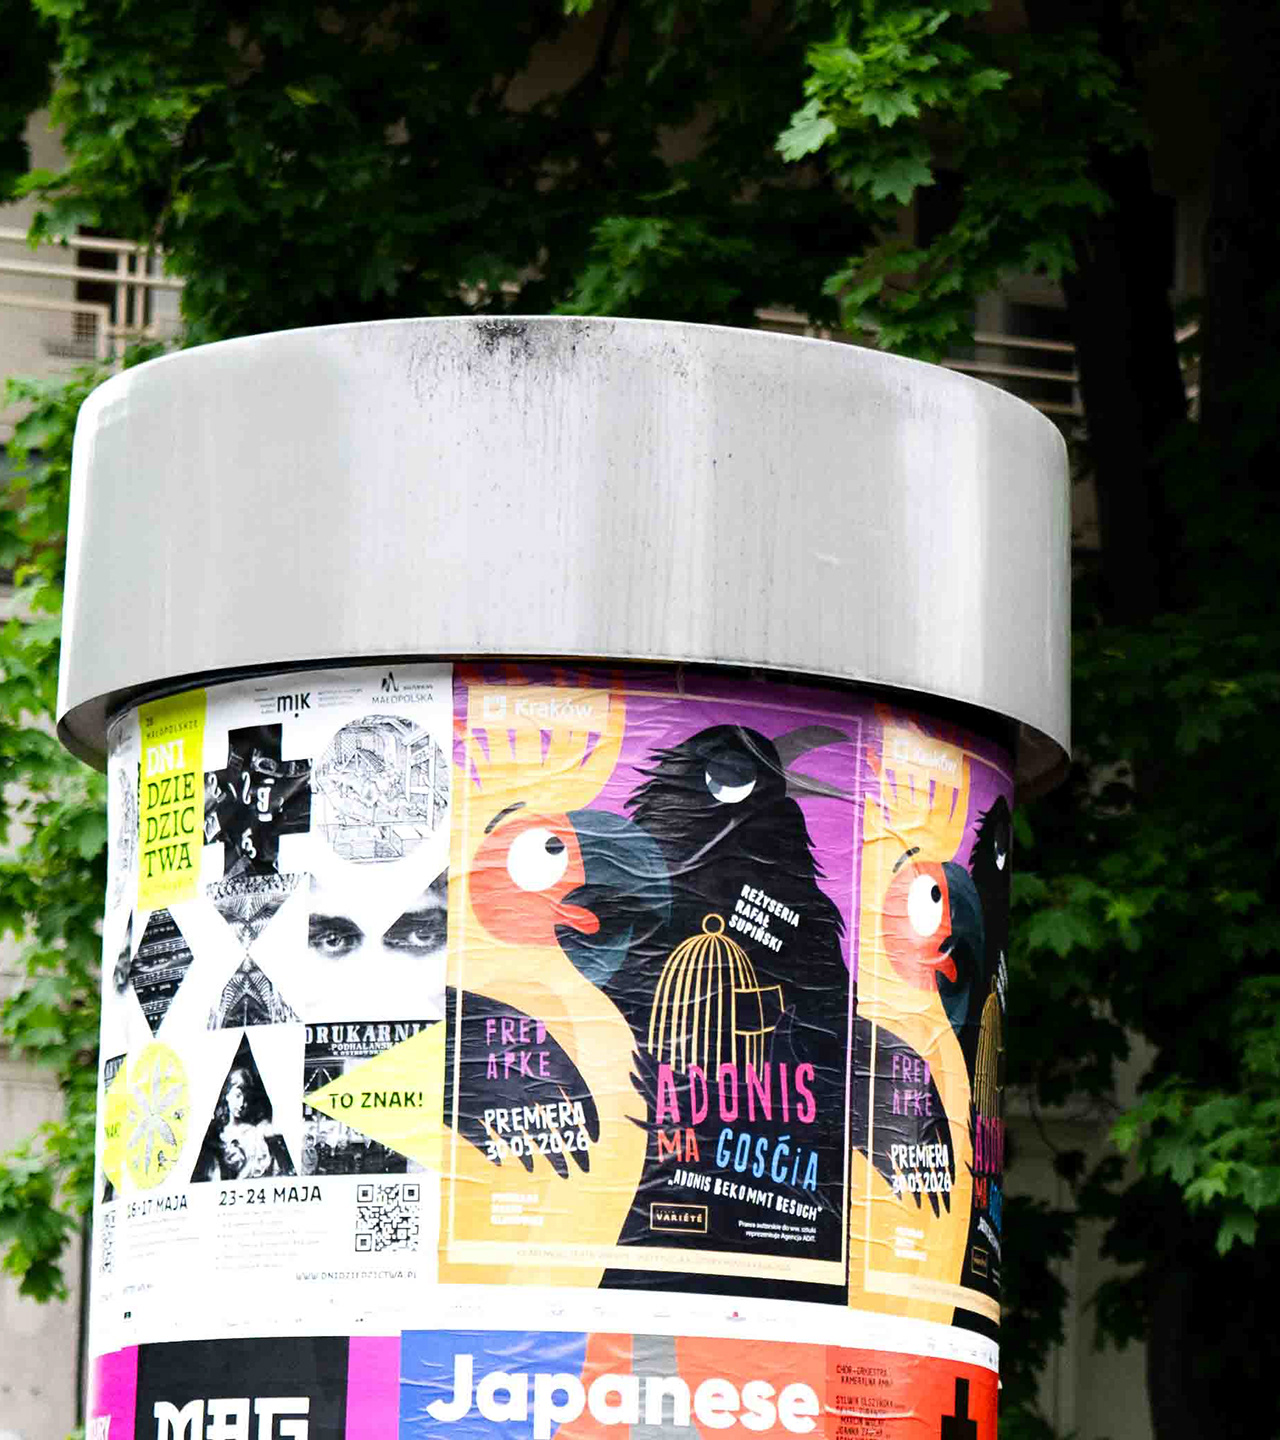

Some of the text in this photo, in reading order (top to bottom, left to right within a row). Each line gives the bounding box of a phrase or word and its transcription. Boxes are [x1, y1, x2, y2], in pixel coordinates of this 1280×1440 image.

[371, 693, 434, 705] MAŁOPOLSKA
[515, 698, 593, 716] Kraków
[146, 739, 185, 777] DNI
[147, 772, 195, 810] DZIE
[145, 806, 195, 844] DZIC
[144, 842, 193, 878] TWA
[734, 899, 770, 928] RAFAŁ
[740, 884, 800, 928] REŻYSERIA
[728, 914, 783, 953] SUPIŃSKI
[305, 1024, 434, 1044] DRUKARNI
[485, 1016, 547, 1047] FRED
[486, 1051, 551, 1080] APKE
[892, 1055, 931, 1084] FRED
[329, 1092, 424, 1109] TO ZNAK!
[656, 1062, 817, 1126] ADONIS
[657, 1127, 700, 1162] MA
[156, 1194, 188, 1213] MAJA
[219, 1186, 322, 1207] 23-24 MAJA
[714, 1178, 774, 1209] BEKOMMT
[656, 1213, 703, 1223] VARIÉTÉ
[425, 1353, 820, 1440] Japanese
